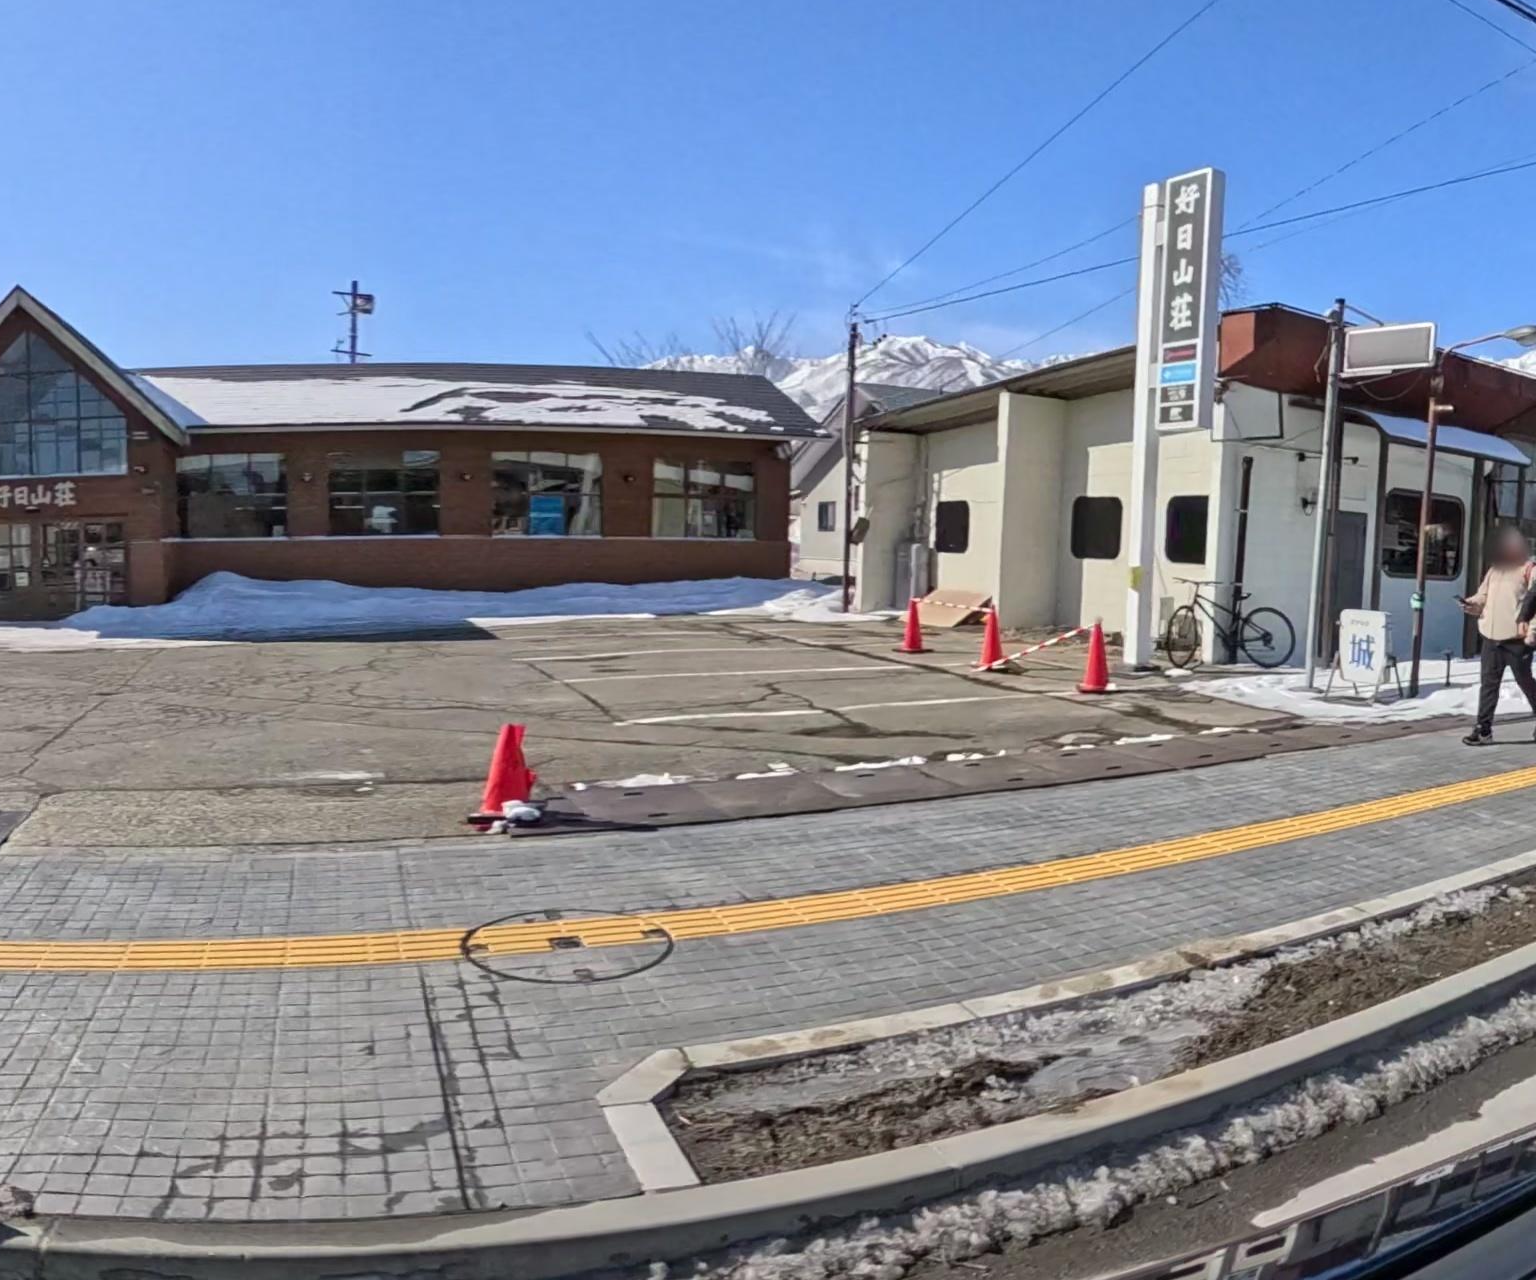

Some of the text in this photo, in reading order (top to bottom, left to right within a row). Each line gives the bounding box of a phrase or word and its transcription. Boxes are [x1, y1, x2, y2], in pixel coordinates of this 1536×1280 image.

[1169, 184, 1200, 331] 好日山荘
[1349, 634, 1375, 671] 城
